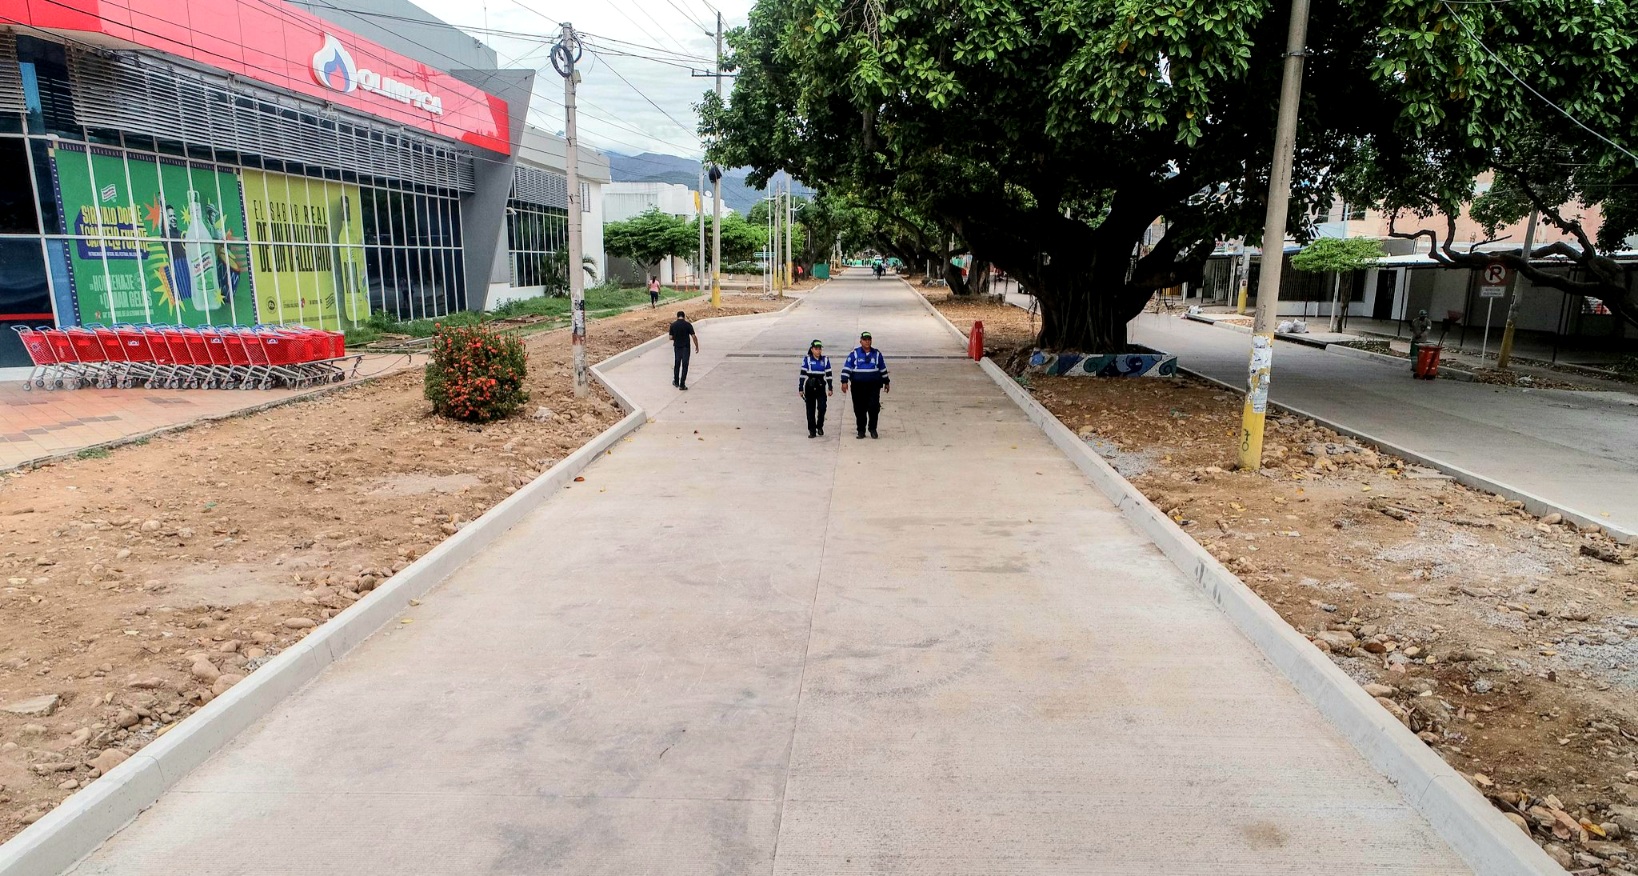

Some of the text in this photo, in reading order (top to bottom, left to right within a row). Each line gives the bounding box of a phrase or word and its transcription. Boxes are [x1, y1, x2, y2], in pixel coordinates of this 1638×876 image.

[253, 199, 264, 220] EL
[303, 204, 328, 225] REAL
[256, 222, 272, 272] DE
[271, 222, 287, 272] UN
[92, 274, 134, 291] HOENAJE
